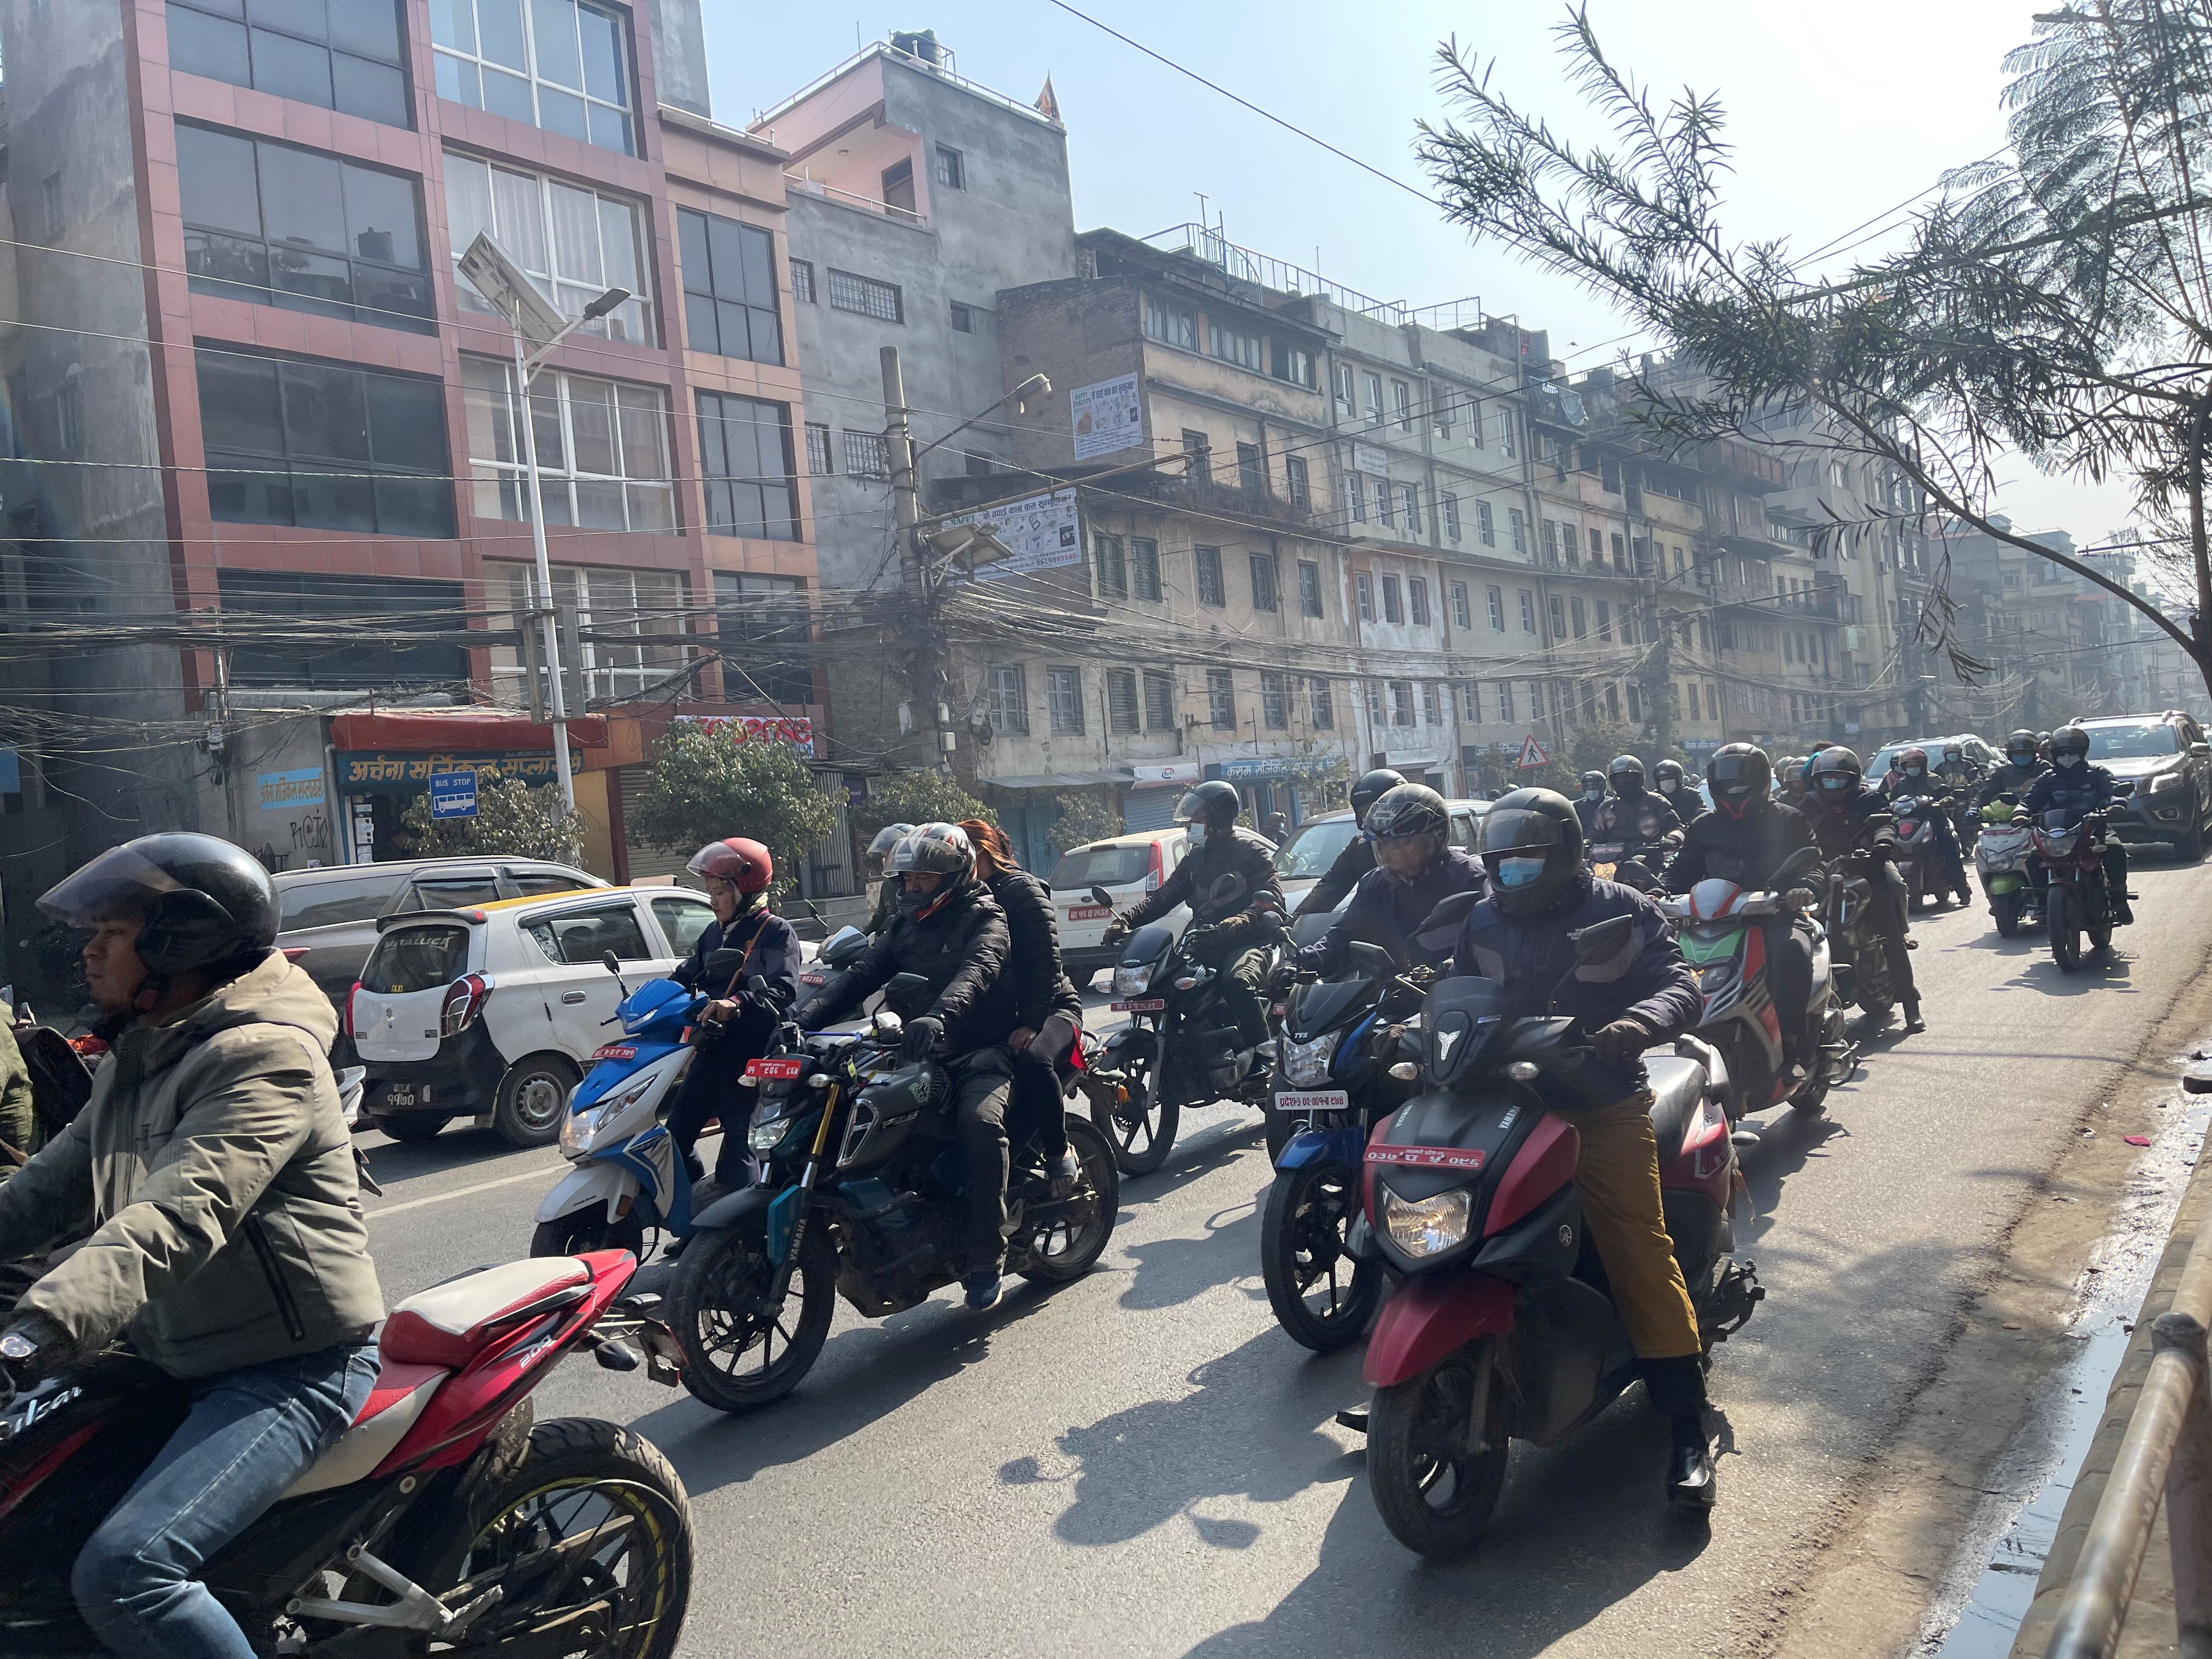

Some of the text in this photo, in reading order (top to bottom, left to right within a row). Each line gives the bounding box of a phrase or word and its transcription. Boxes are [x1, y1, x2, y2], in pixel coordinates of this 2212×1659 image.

[348, 755, 405, 782] अर्चना
[453, 778, 471, 787] STOP
[391, 985, 404, 993] TAXI
[1498, 1105, 1523, 1129] YAMAHA
[789, 1218, 808, 1260] YAMAHA
[520, 1334, 552, 1368] 200
[0, 1386, 82, 1441] ulsar
